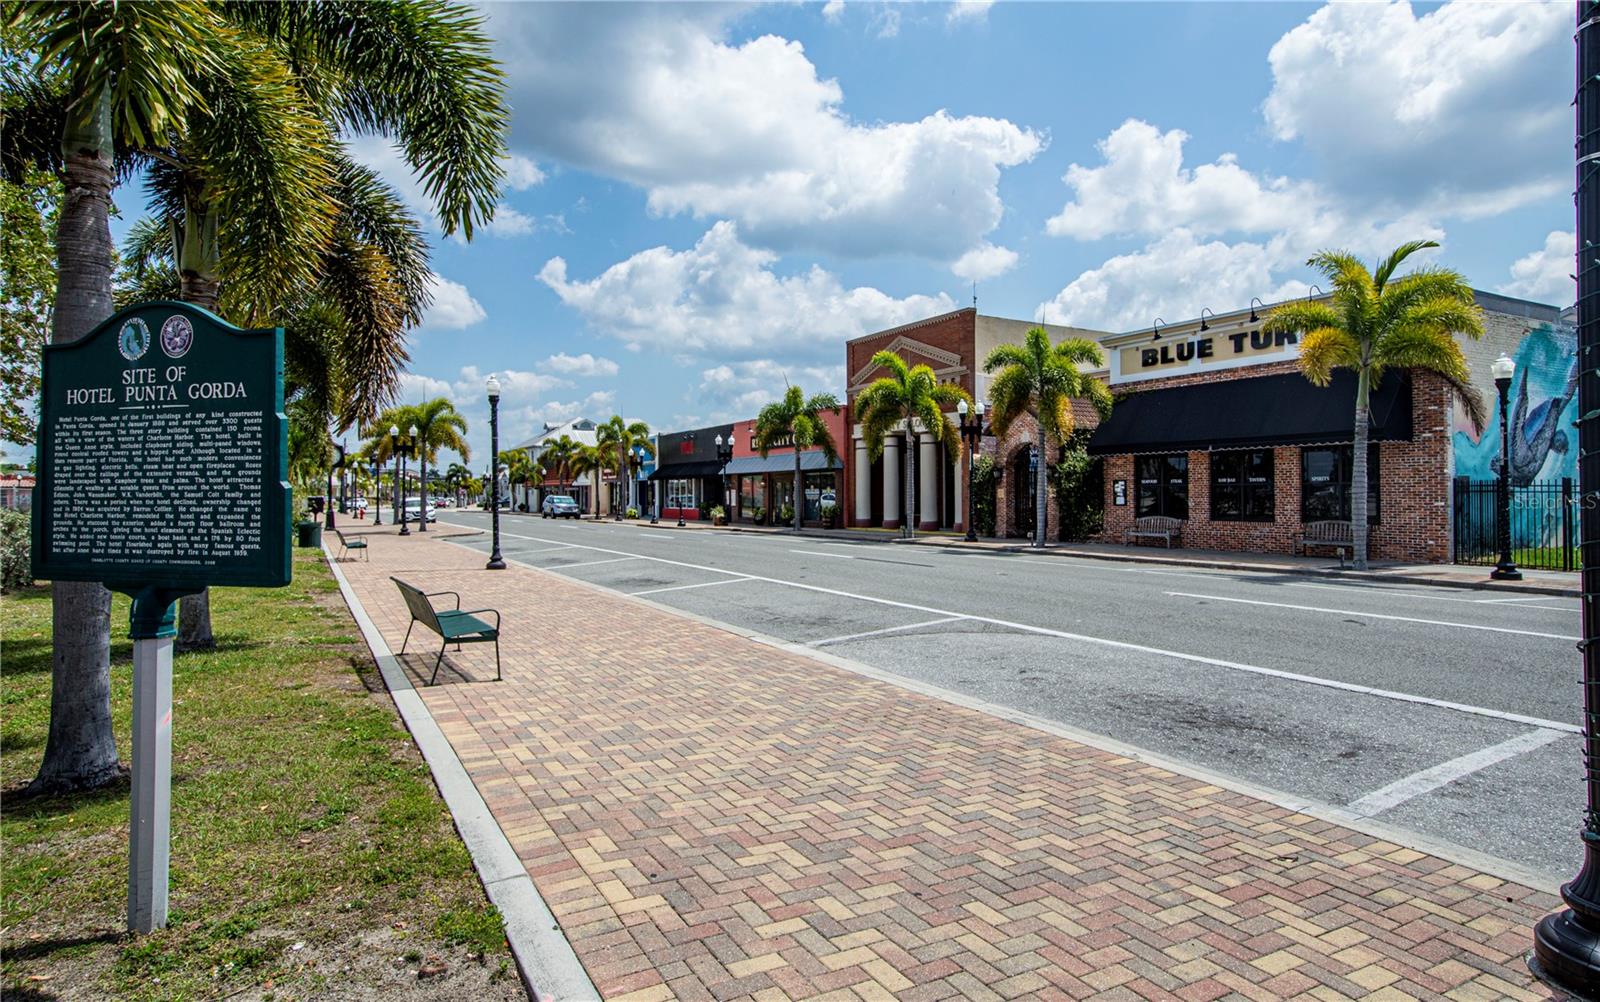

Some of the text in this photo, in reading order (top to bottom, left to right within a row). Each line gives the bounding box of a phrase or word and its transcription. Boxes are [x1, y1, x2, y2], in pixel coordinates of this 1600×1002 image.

[1142, 326, 1298, 368] BLUE TUR
[122, 366, 186, 384] SITE OF
[66, 382, 248, 404] HOTEL PUNTA GORDA
